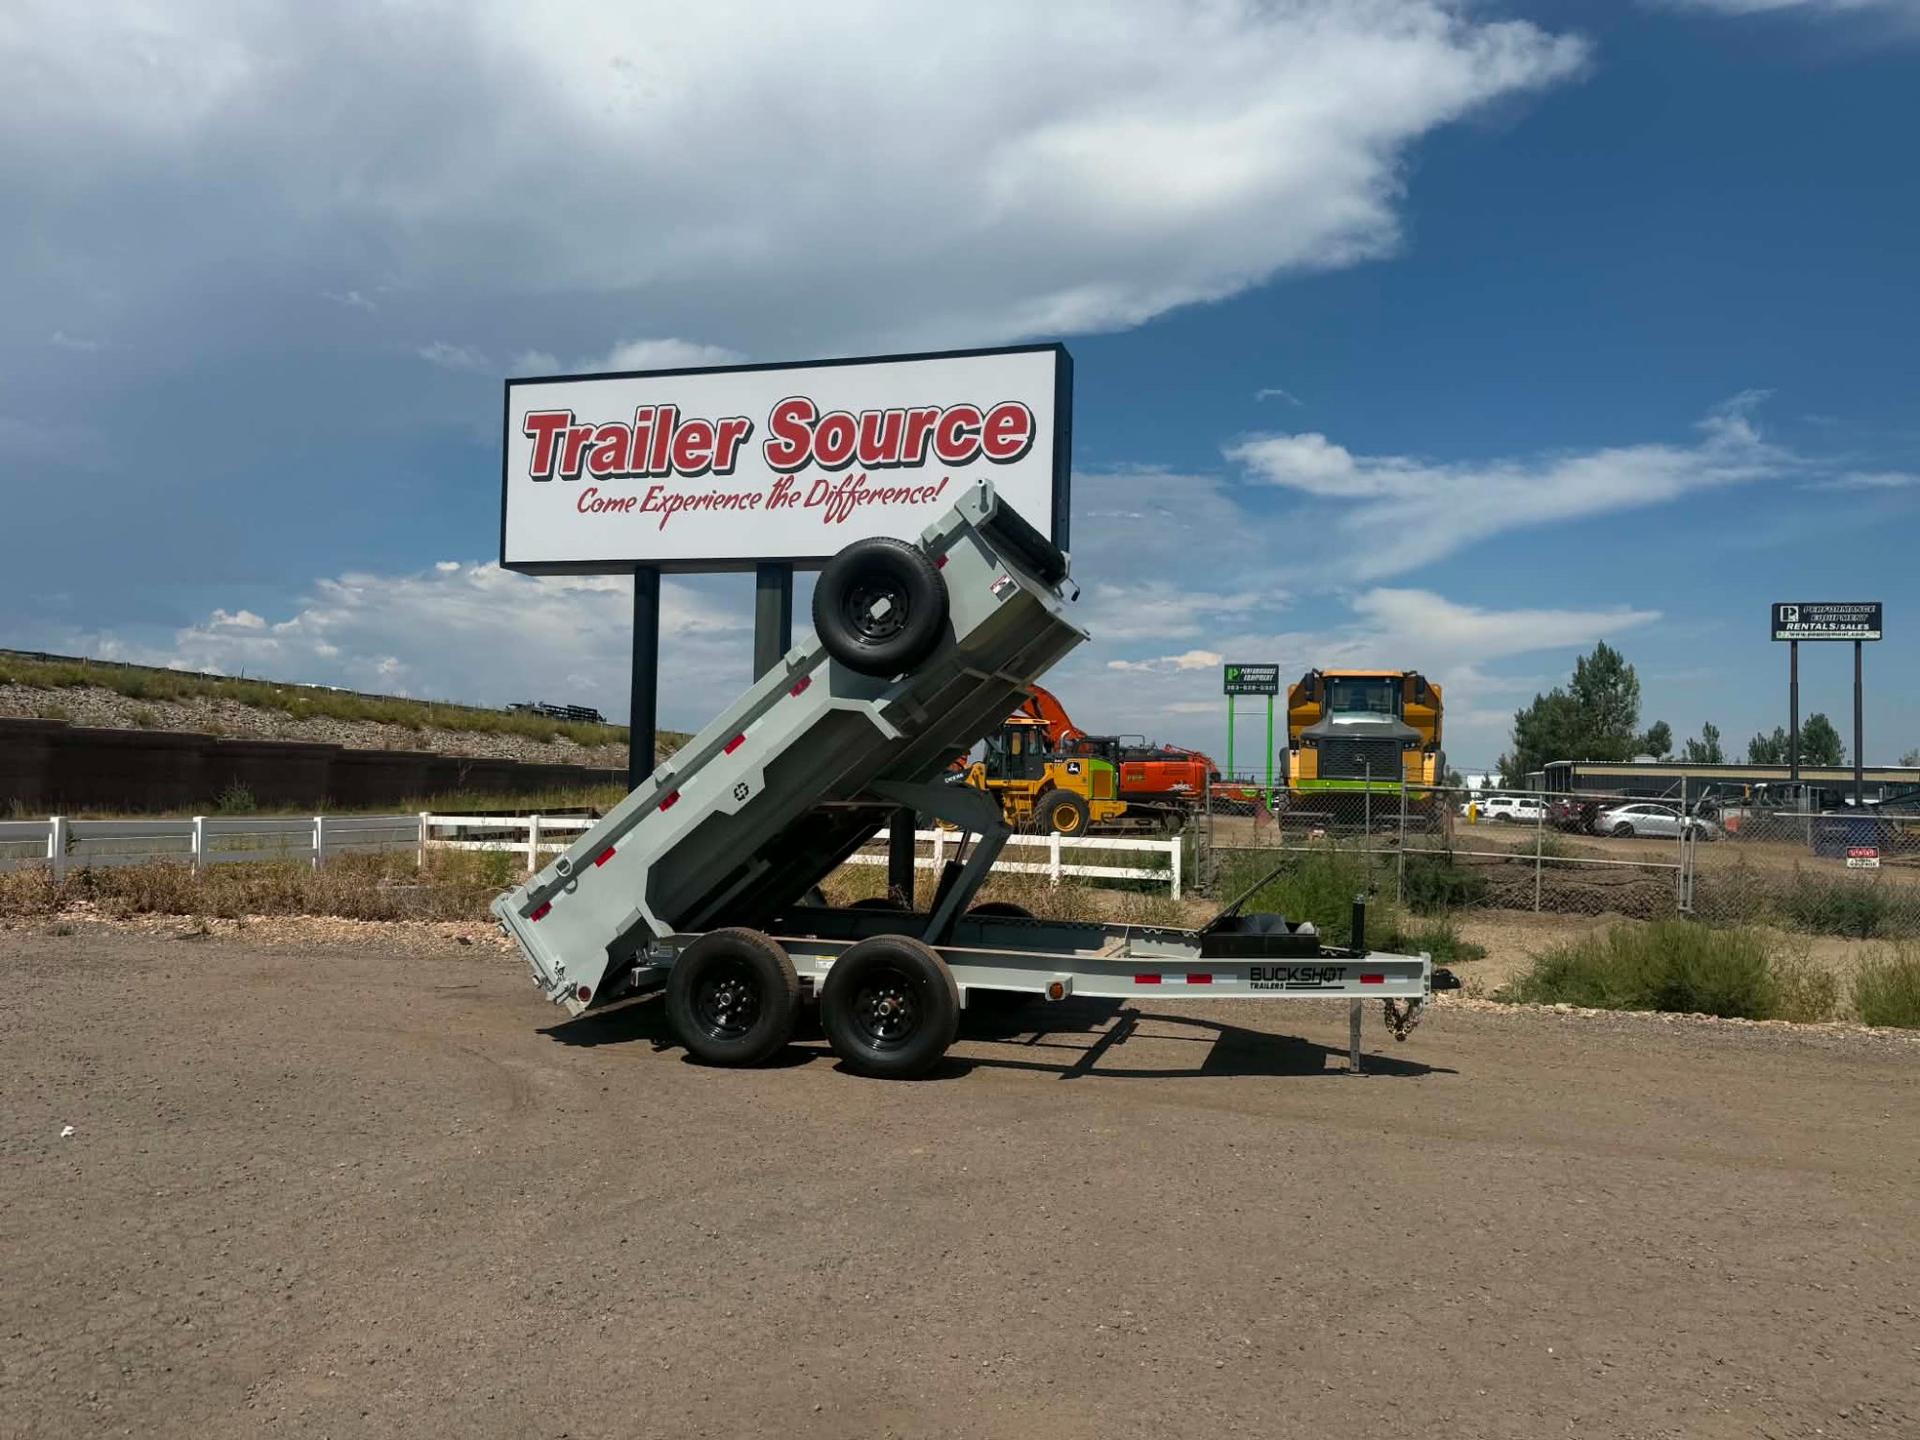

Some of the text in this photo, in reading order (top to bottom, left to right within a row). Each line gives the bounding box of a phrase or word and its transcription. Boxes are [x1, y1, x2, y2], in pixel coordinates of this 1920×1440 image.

[523, 396, 1036, 482] Trailer Source
[577, 473, 949, 531] Come Experience the Difference!
[1250, 967, 1347, 983] BUCKSHOT
[1250, 982, 1285, 990] TRAILERS
